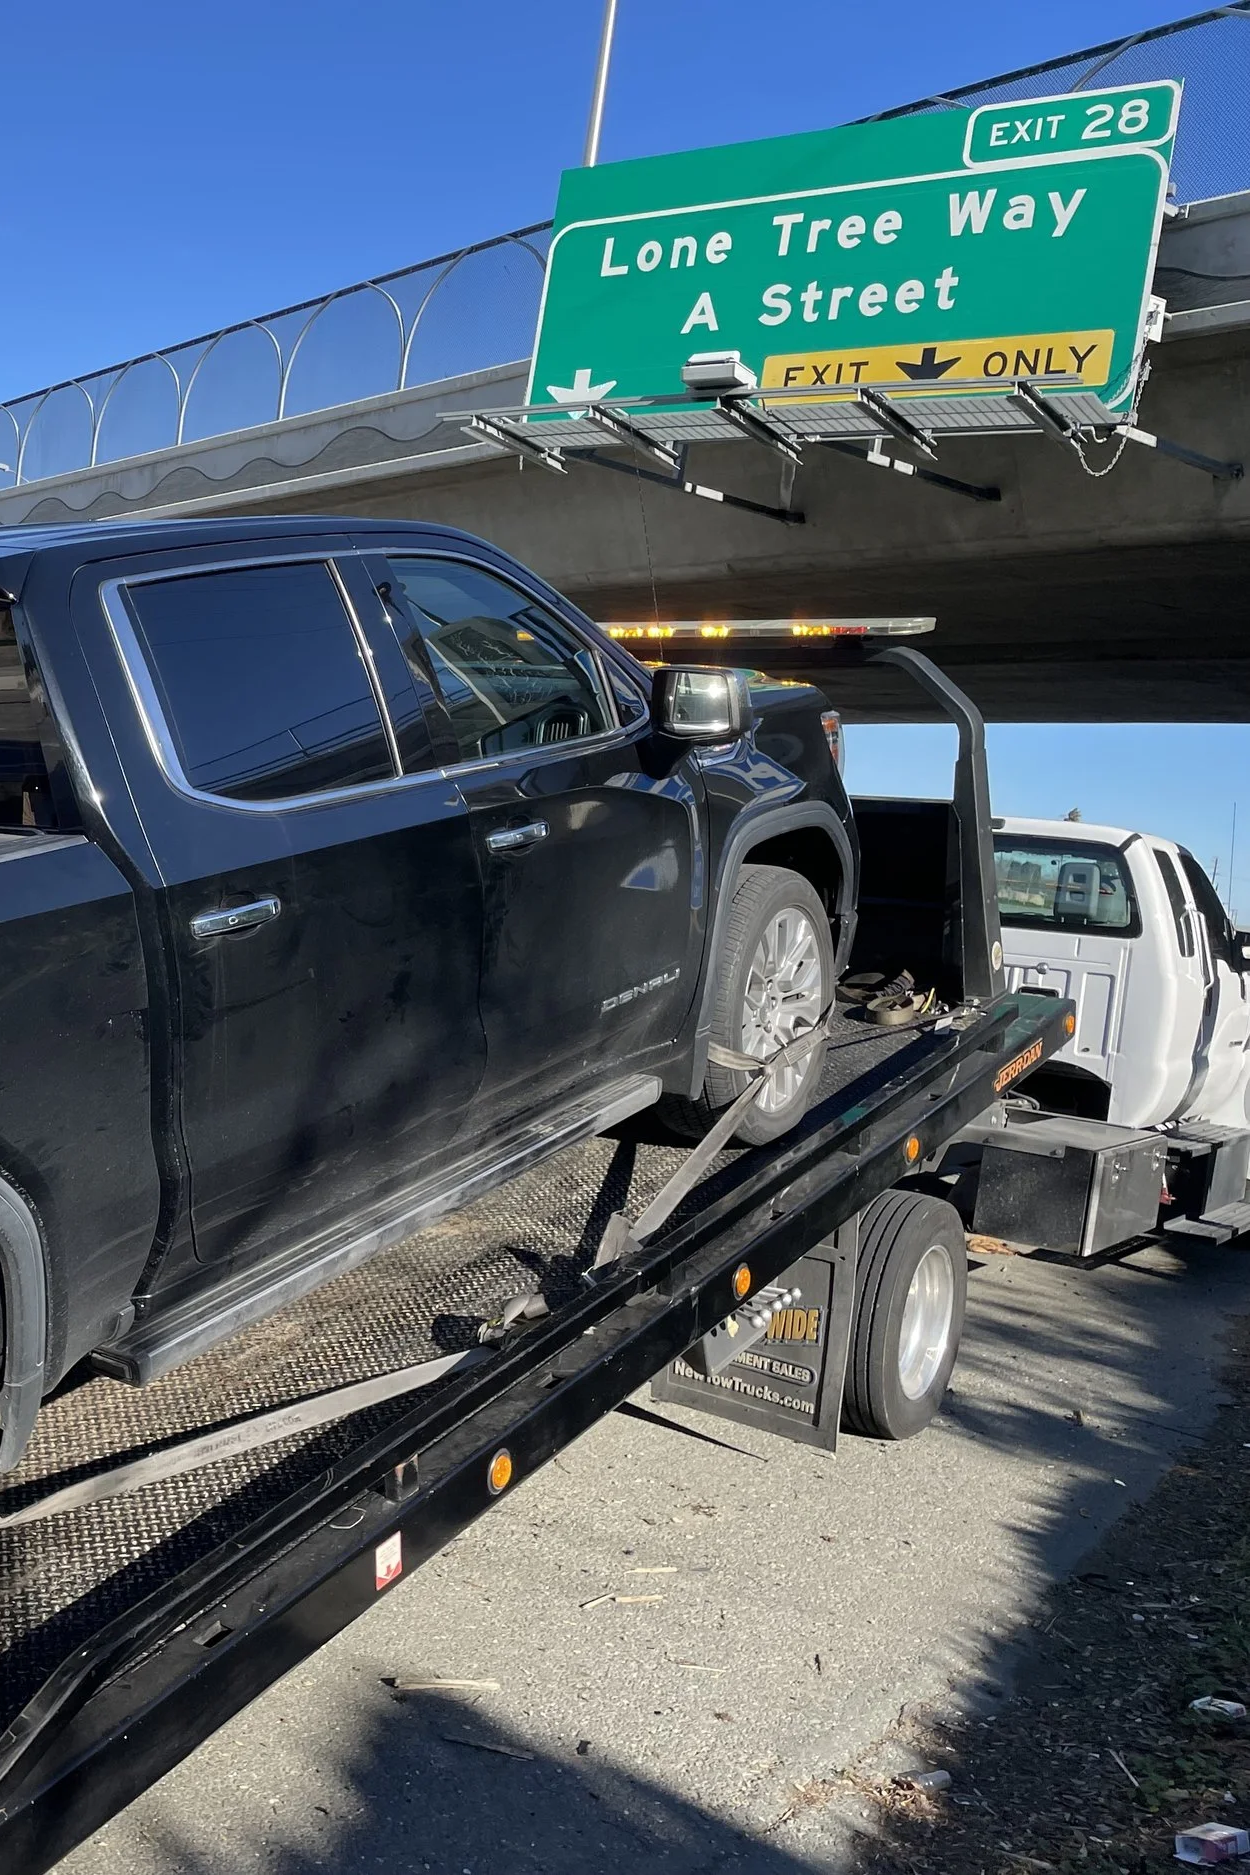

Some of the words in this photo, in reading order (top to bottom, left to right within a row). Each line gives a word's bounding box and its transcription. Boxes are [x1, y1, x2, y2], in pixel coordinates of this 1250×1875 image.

[989, 114, 1066, 147] EXIT
[1081, 99, 1150, 140] 28
[600, 231, 733, 277] Lone
[772, 210, 903, 257] Tree
[949, 188, 1088, 238] Way
[680, 292, 720, 334] A
[758, 266, 960, 326] Street
[783, 360, 870, 387] EXIT
[982, 344, 1098, 377] ONLY
[673, 1360, 815, 1415] NewowTrucks.com
[771, 1360, 811, 1383] SALES
